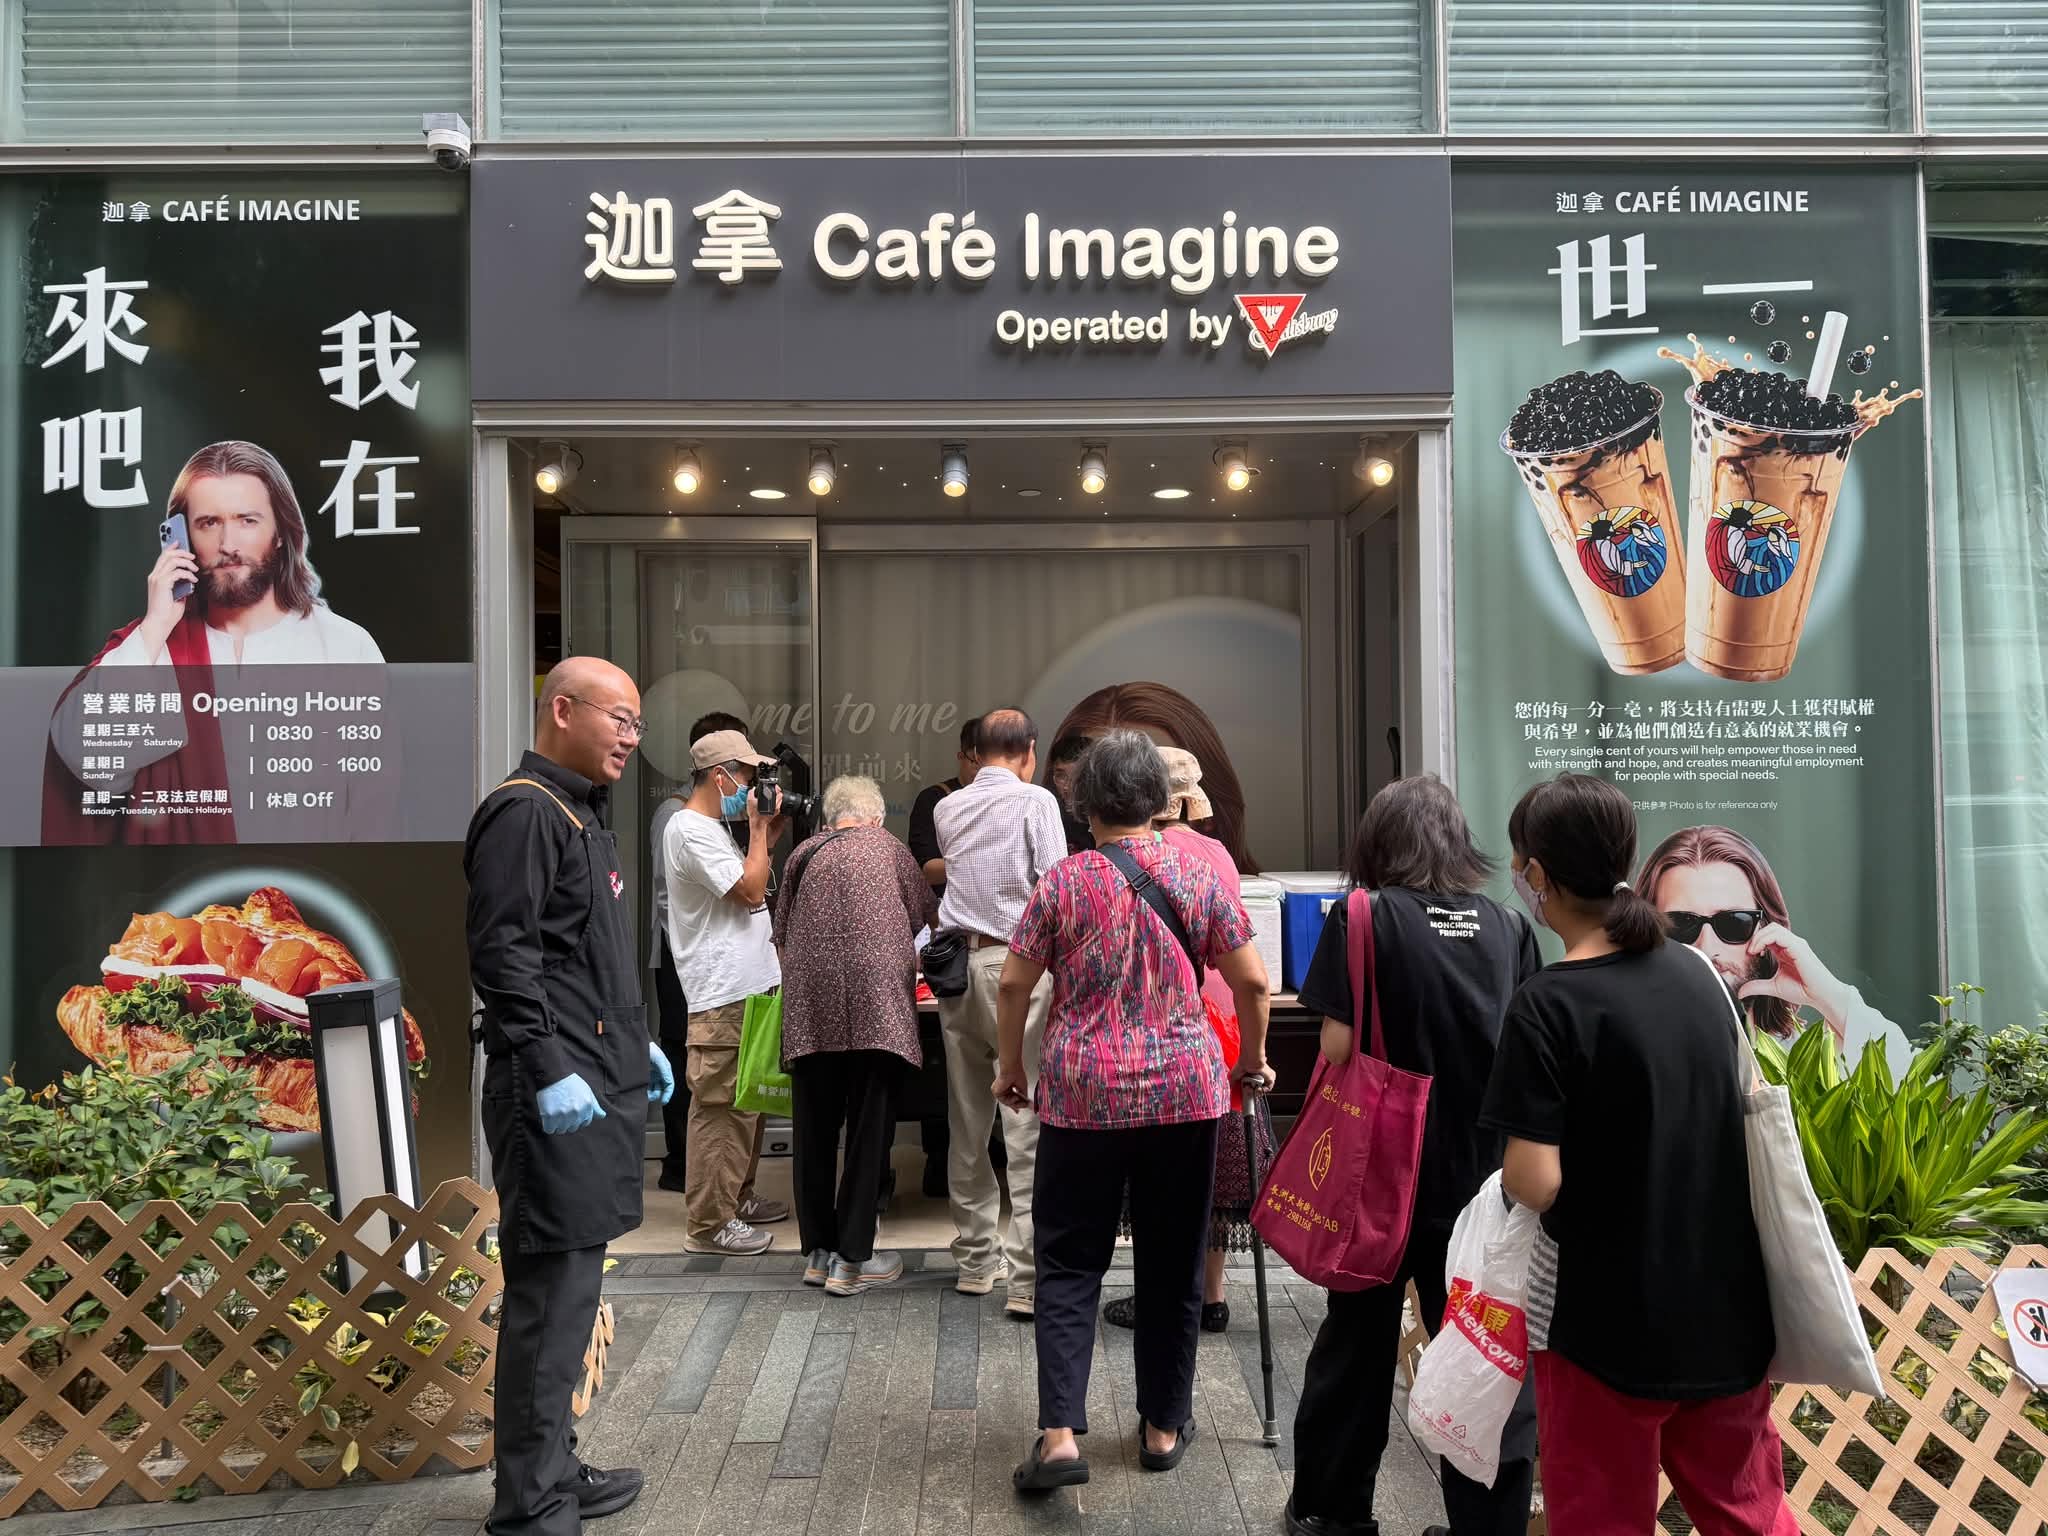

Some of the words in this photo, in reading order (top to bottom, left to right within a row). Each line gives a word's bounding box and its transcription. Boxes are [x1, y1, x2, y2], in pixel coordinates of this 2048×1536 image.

[1555, 192, 1605, 214] 迦拿
[1615, 185, 1682, 213] CAFÉ
[1689, 190, 1810, 213] IMAGINE
[101, 201, 152, 223] 迦拿
[162, 194, 230, 222] CAFÉ
[238, 199, 361, 222] IMAGINE
[584, 189, 783, 286] 迦拿
[813, 209, 998, 283] Café
[1024, 211, 1341, 296] Imagine
[996, 307, 1169, 349] Operated
[1189, 308, 1234, 350] by
[83, 693, 181, 714] 營業時間
[192, 692, 298, 717] Opening
[305, 691, 382, 712] Hours
[832, 692, 876, 735] to
[889, 701, 958, 736] me
[82, 723, 155, 737] 星期三至六
[266, 725, 313, 741] 0830
[337, 725, 382, 740] 1830
[82, 739, 133, 748] Wednesday
[144, 738, 184, 748] Saturday
[1535, 746, 1568, 758] Every
[1570, 745, 1603, 758] single
[1606, 746, 1631, 756] cent
[1633, 745, 1645, 756] of
[1646, 746, 1679, 758] yours
[1681, 745, 1698, 755] will
[1701, 744, 1725, 757] help
[1727, 746, 1780, 757] empower
[1782, 743, 1814, 754] those
[1816, 743, 1826, 754] in
[1828, 743, 1857, 754] need
[82, 756, 125, 769] 星期日
[266, 757, 313, 773] 0800
[337, 757, 382, 772] 1600
[1528, 758, 1552, 769] with
[1554, 758, 1602, 770] strength
[1604, 758, 1626, 769] and
[1628, 758, 1660, 771] hope,
[1662, 758, 1684, 769] and
[1686, 758, 1729, 768] creates
[1731, 757, 1792, 769] meaningful
[1795, 756, 1865, 769] employment
[82, 772, 115, 781] Sunday
[1615, 770, 1631, 781] for
[1633, 771, 1670, 783] people
[1673, 769, 1696, 781] with
[1699, 769, 1739, 783] special
[1741, 769, 1780, 781] needs.
[82, 790, 228, 804] 星期一、二及法定假期
[266, 793, 298, 808] 休息
[302, 792, 334, 807] Off
[168, 806, 193, 814] Public
[195, 806, 233, 815] Holidays
[1669, 800, 1695, 810] Photo
[1696, 800, 1704, 810] is
[1705, 800, 1717, 810] for
[1718, 800, 1759, 809] reference
[1760, 800, 1778, 811] only
